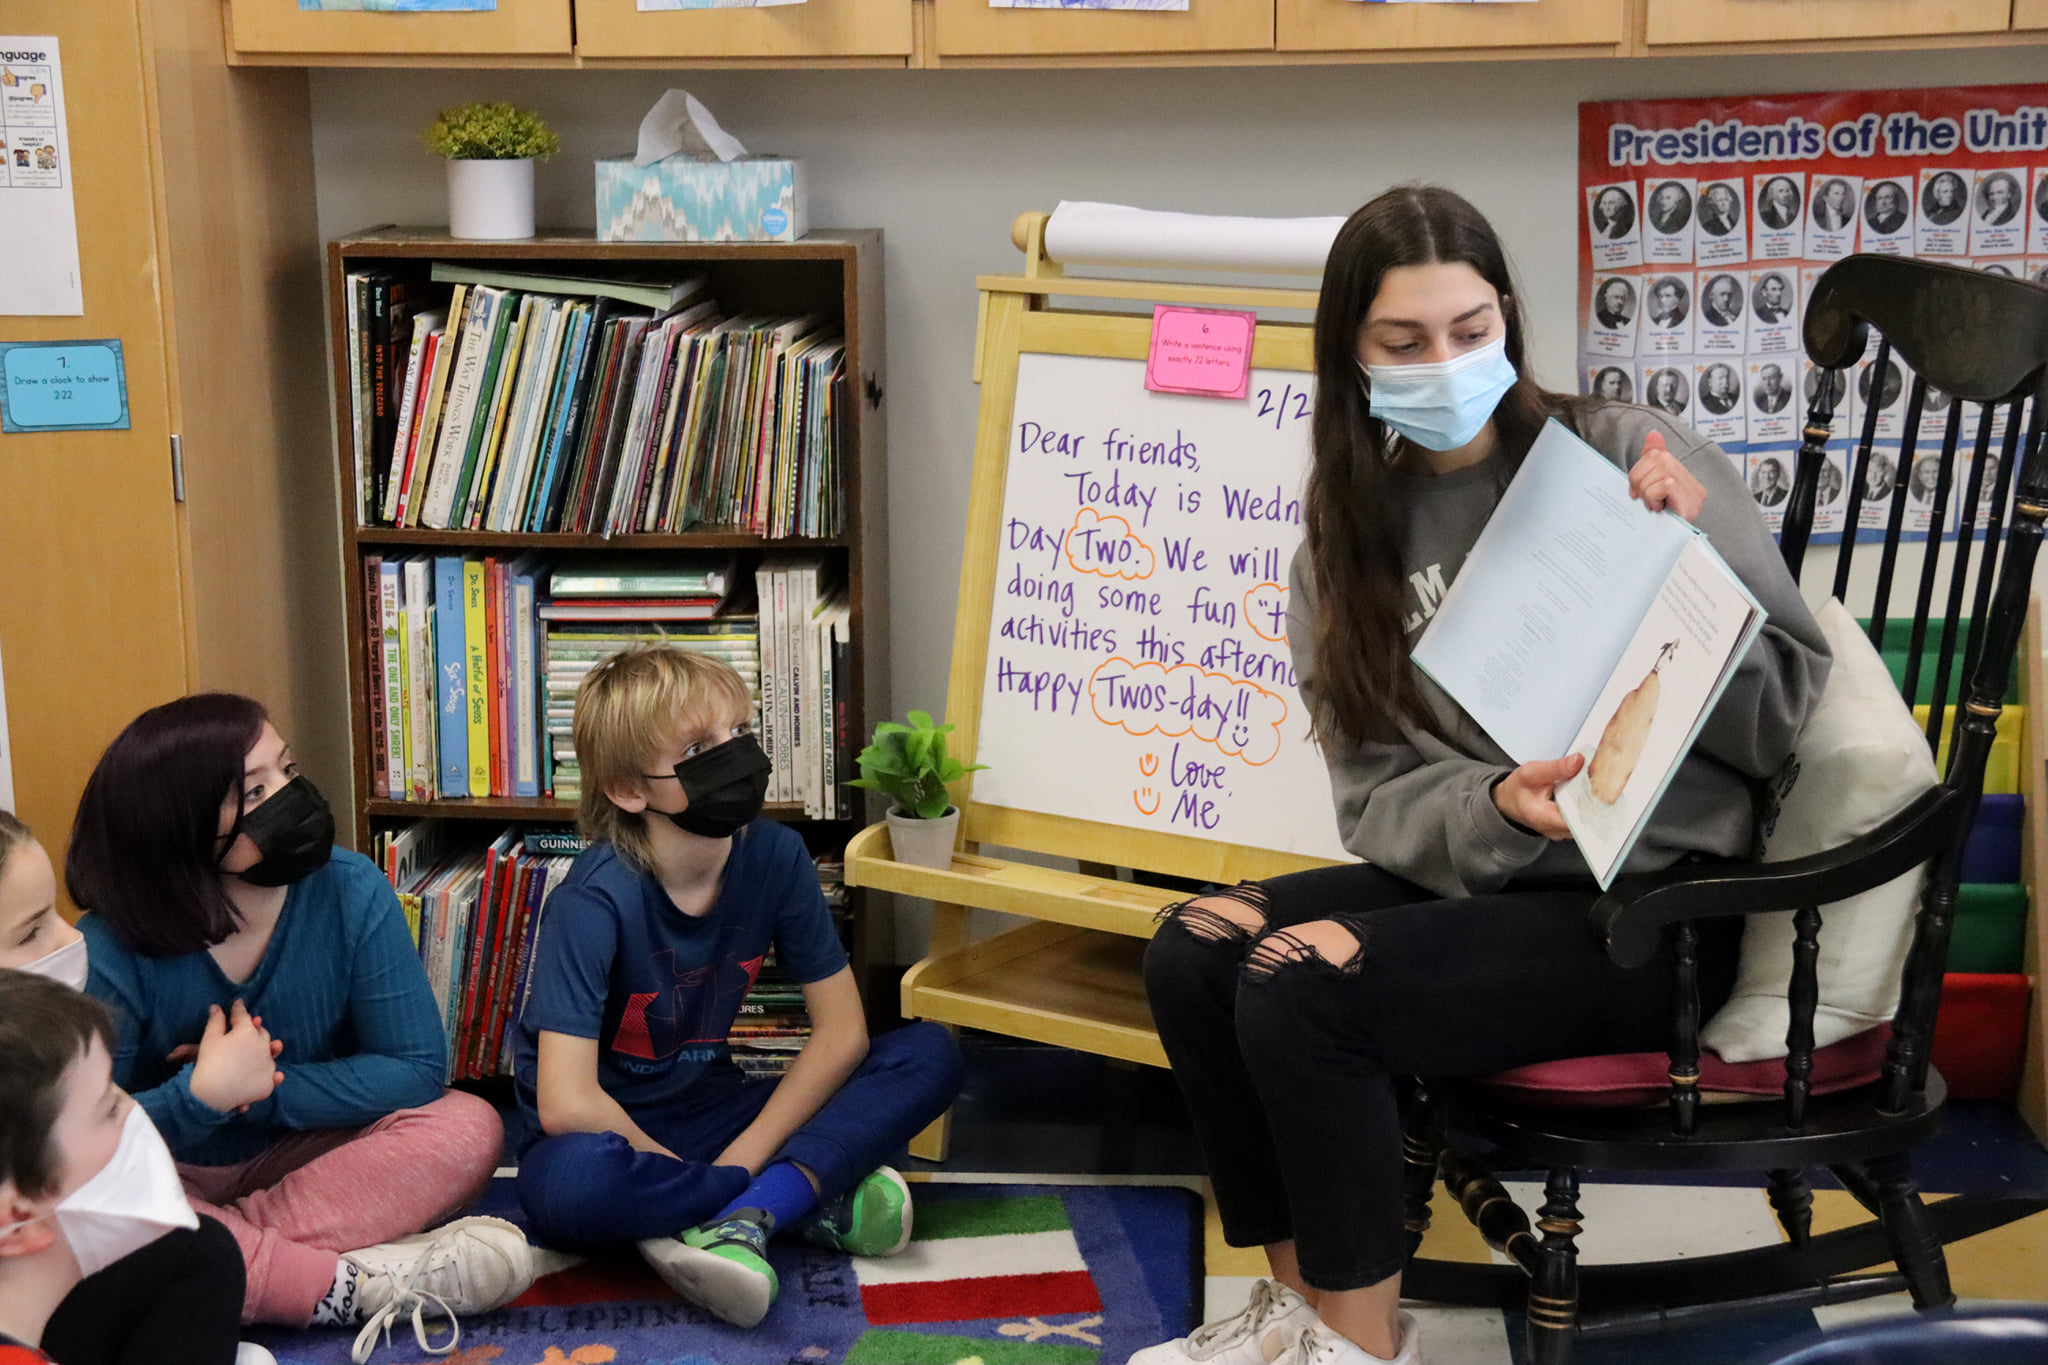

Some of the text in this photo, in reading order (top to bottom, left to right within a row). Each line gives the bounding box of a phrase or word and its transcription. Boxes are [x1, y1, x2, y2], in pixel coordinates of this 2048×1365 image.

[1612, 121, 1820, 162] Presidents
[1832, 116, 1875, 152] of
[1888, 115, 1955, 151] the
[1162, 339, 1182, 347] Write
[14, 376, 39, 386] Draw
[50, 375, 73, 385] clock
[76, 375, 86, 384] to
[88, 374, 110, 383] show
[376, 345, 384, 417] INTO THE VOLCANO
[407, 359, 417, 379] SAY
[444, 331, 482, 457] THE WAY THINGS WORK
[1256, 383, 1313, 430] 2/2
[1018, 421, 1201, 473] Dear friends,
[1063, 468, 1301, 528] Today is Wedn
[1007, 517, 1279, 583] Day Two. We will
[469, 573, 480, 609] Dr. Seuss
[1007, 562, 1075, 617] doing
[1098, 585, 1162, 616] some
[1186, 586, 1236, 629] fun
[1000, 613, 1118, 653] activities
[1136, 624, 1185, 665] this
[443, 662, 461, 681] Six
[471, 653, 482, 683] Hatful
[823, 669, 831, 686] THE
[997, 656, 1083, 716] Happy
[386, 648, 401, 760] THE ONE AND ONLY SHREK!
[445, 686, 465, 714] Seuss
[473, 685, 482, 696] of
[764, 674, 773, 712] CALVIN
[778, 678, 788, 718] CALVIN
[823, 688, 831, 709] DAYS
[472, 697, 484, 725] Seuss
[780, 729, 791, 771] HOBBES
[1170, 790, 1220, 830] Me
